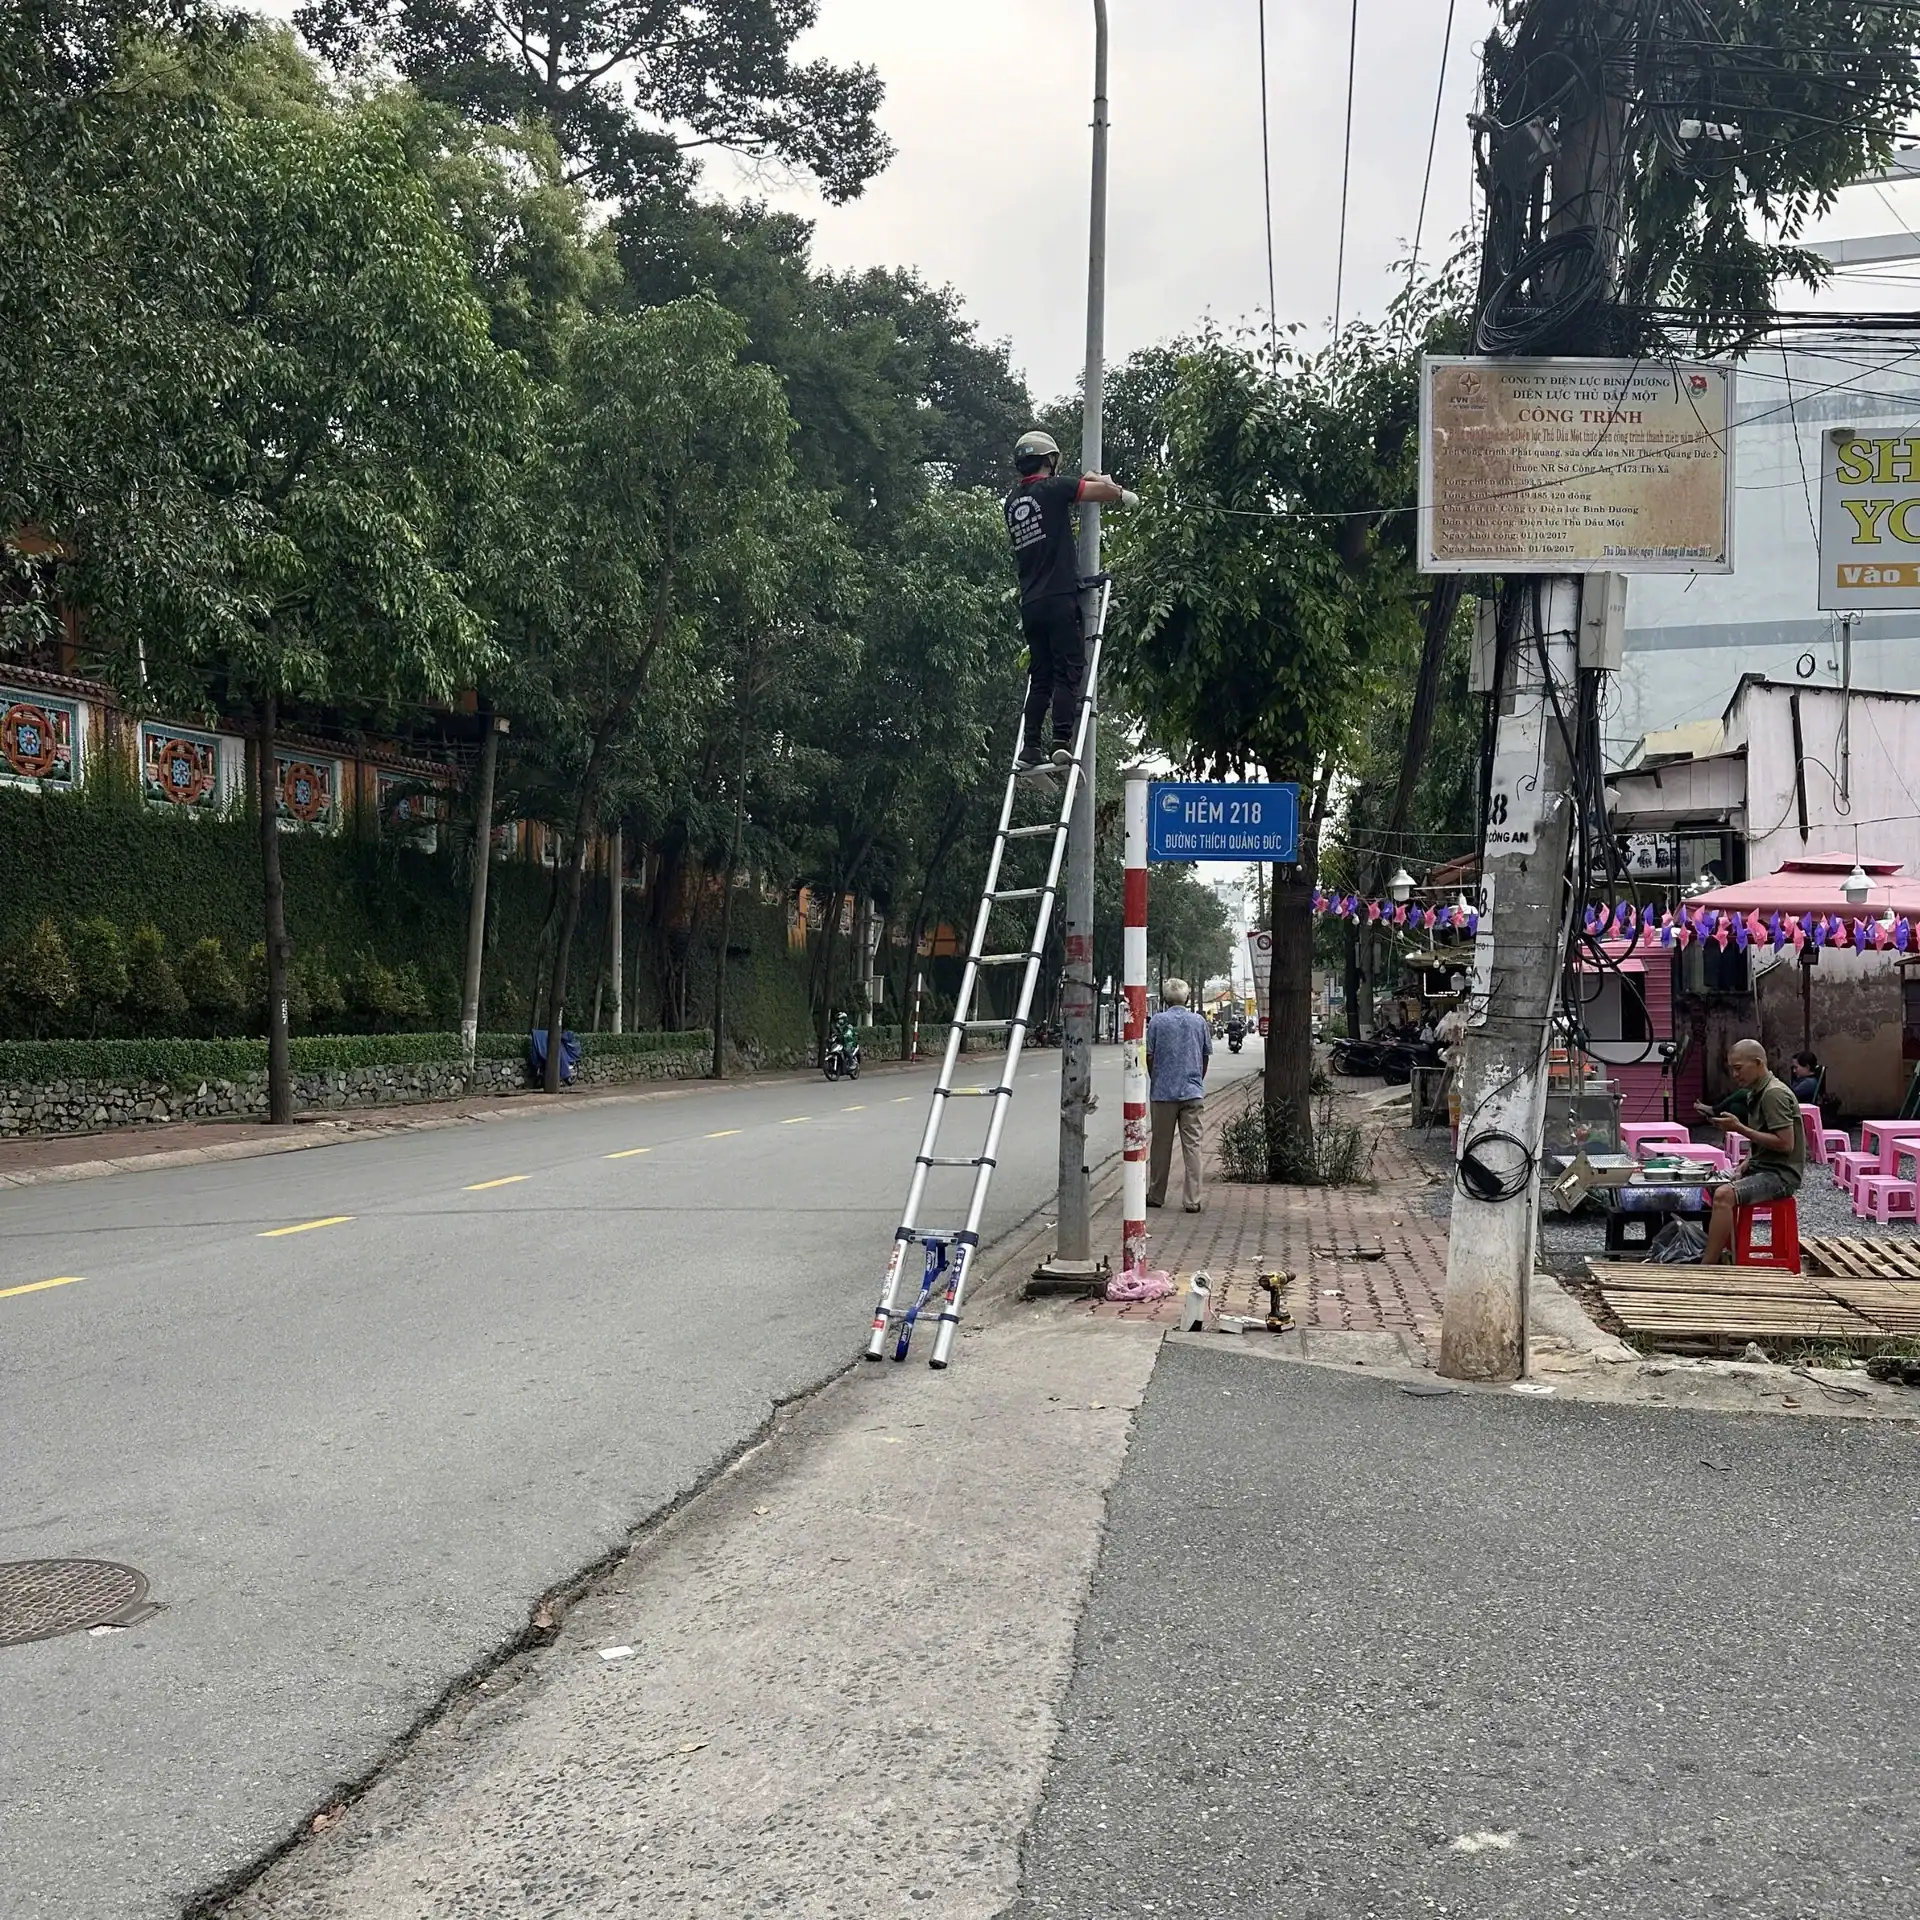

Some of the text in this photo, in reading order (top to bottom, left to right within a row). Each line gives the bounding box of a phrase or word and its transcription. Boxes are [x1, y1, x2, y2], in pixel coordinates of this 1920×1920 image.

[1534, 377, 1546, 385] TY
[1633, 377, 1670, 387] DƯƠNG
[1546, 389, 1570, 401] LỰC
[1574, 388, 1599, 400] THỦ
[1632, 389, 1658, 403] MỘT
[1518, 406, 1644, 424] CÔNG TRÌNH
[1622, 449, 1635, 457] NR
[1541, 464, 1554, 472] NR
[1836, 438, 1920, 485] SH
[1842, 566, 1900, 584] Vào
[1184, 796, 1262, 824] HẺM 218
[1165, 830, 1282, 850] ĐƯỜNG THÍCH QUẢNG ĐỨC
[1511, 832, 1529, 844] AN
